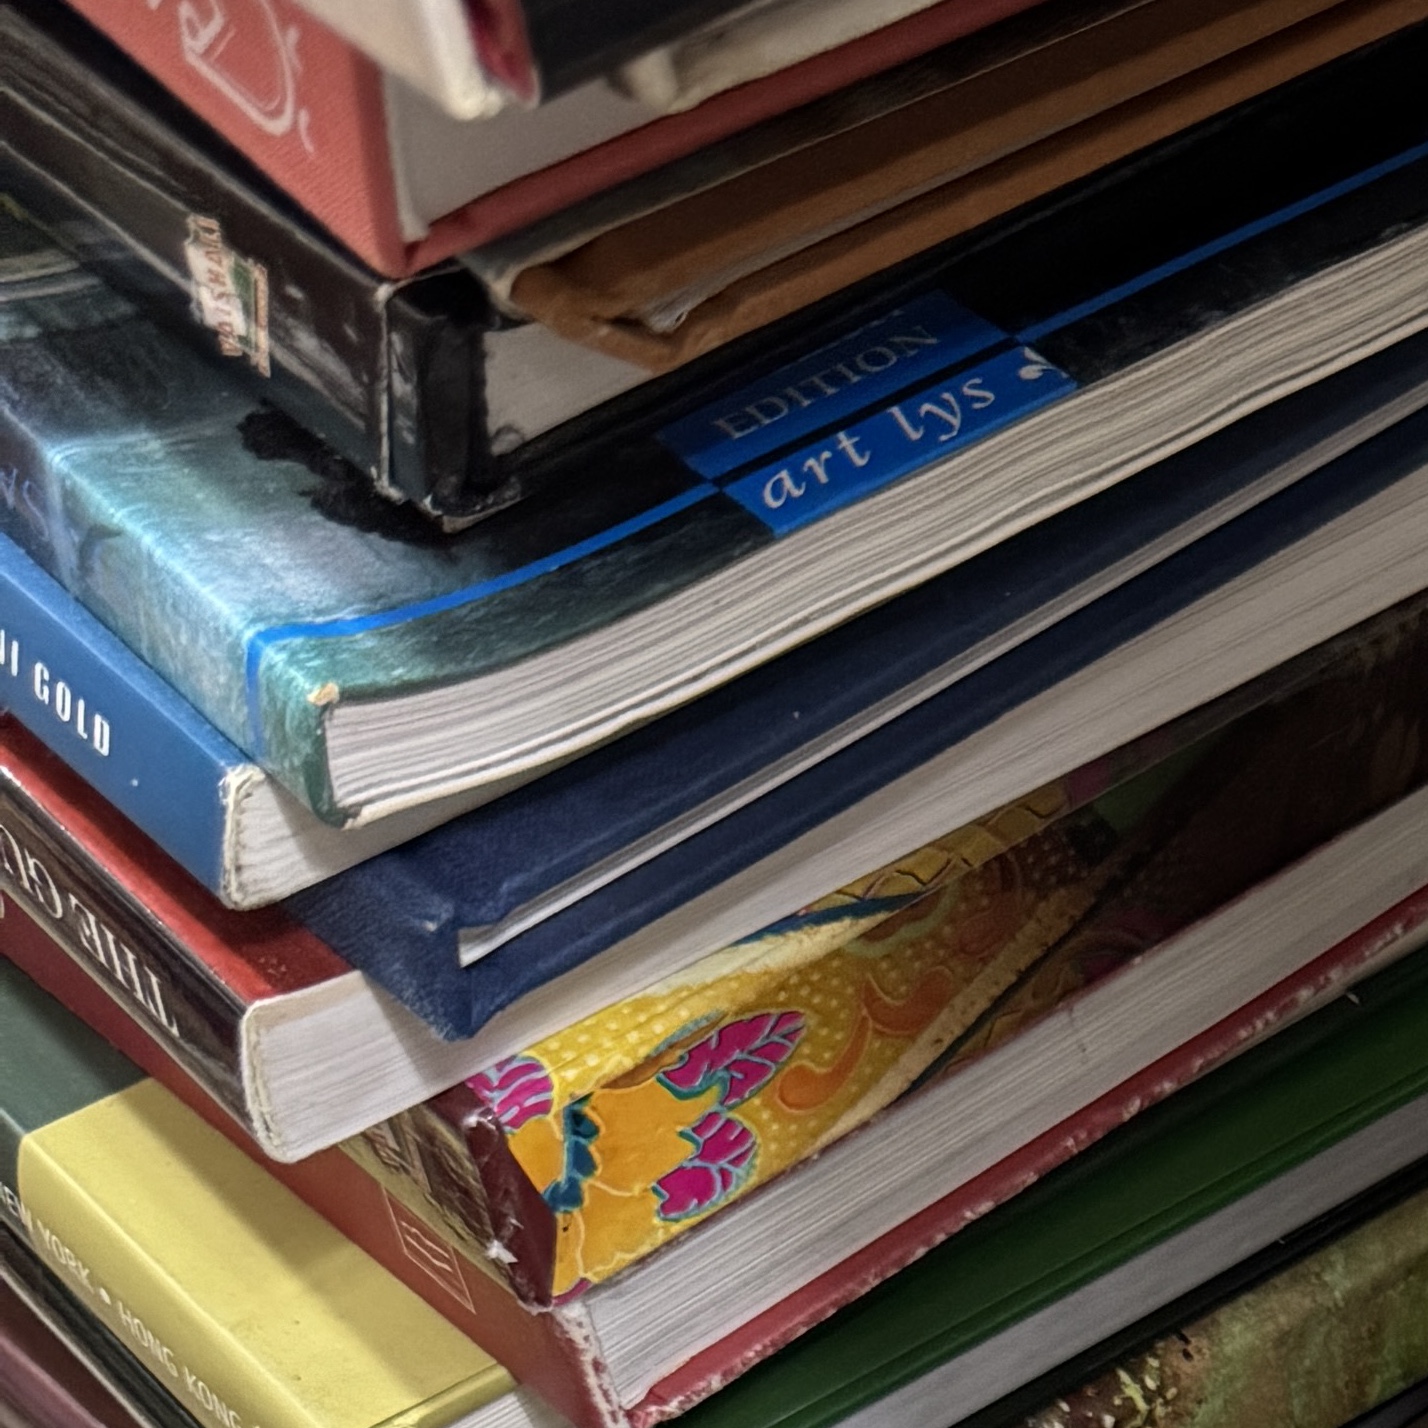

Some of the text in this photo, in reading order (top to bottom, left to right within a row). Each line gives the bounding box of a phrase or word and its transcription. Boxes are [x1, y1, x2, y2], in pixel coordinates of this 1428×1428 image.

[714, 325, 938, 440] EDITION
[762, 377, 996, 509] art lys
[35, 664, 112, 757] GOLD
[71, 893, 180, 1037] THE
[37, 1220, 94, 1294] YORK
[118, 1301, 178, 1377] HONG
